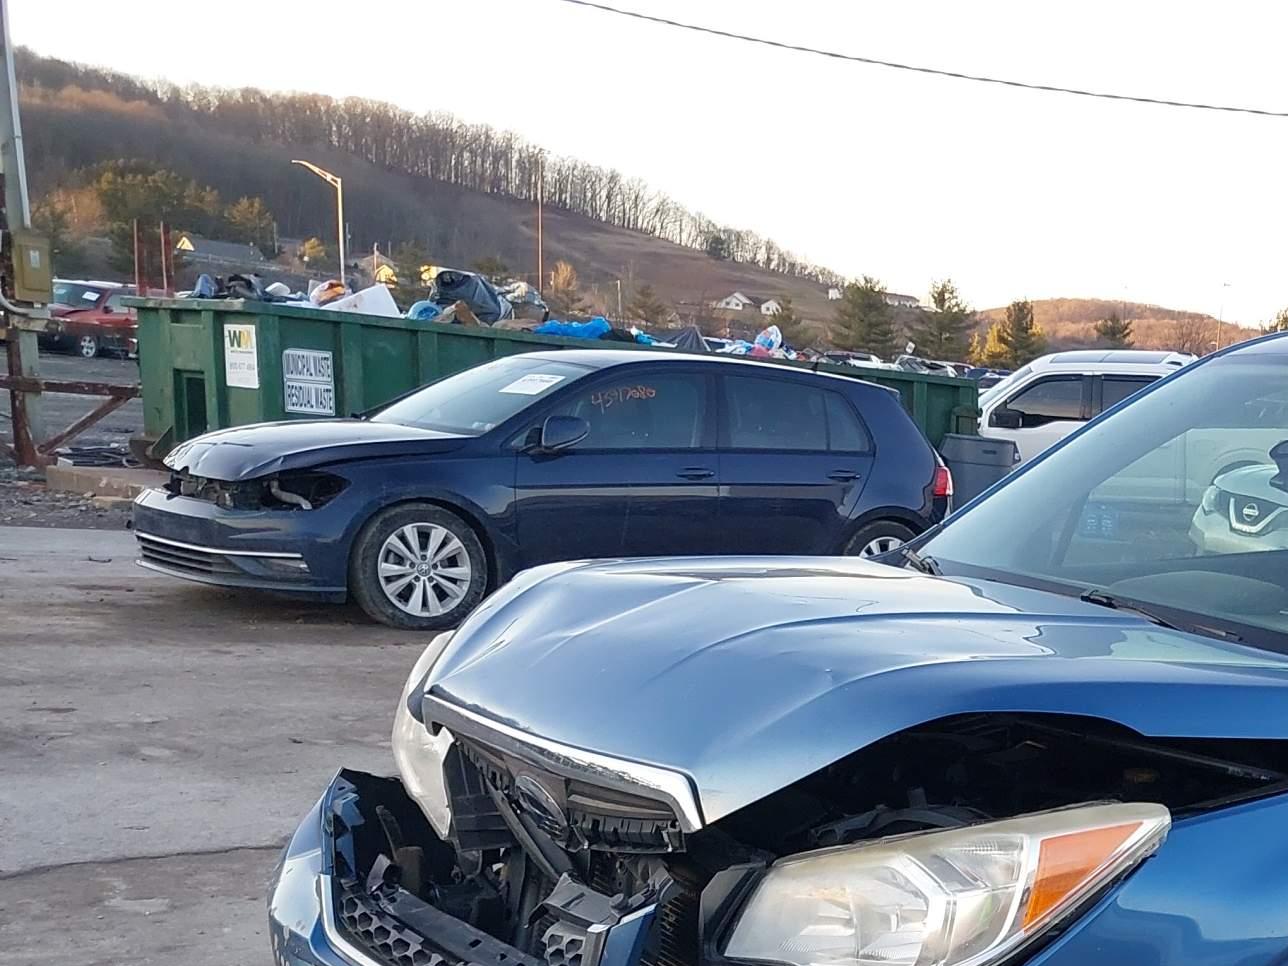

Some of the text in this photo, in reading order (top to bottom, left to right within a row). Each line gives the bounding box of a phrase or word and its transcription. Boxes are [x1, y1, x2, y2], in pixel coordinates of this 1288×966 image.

[285, 353, 331, 378] MUNICIPAL WASTE
[287, 384, 332, 410] RESIDUAL WASTE
